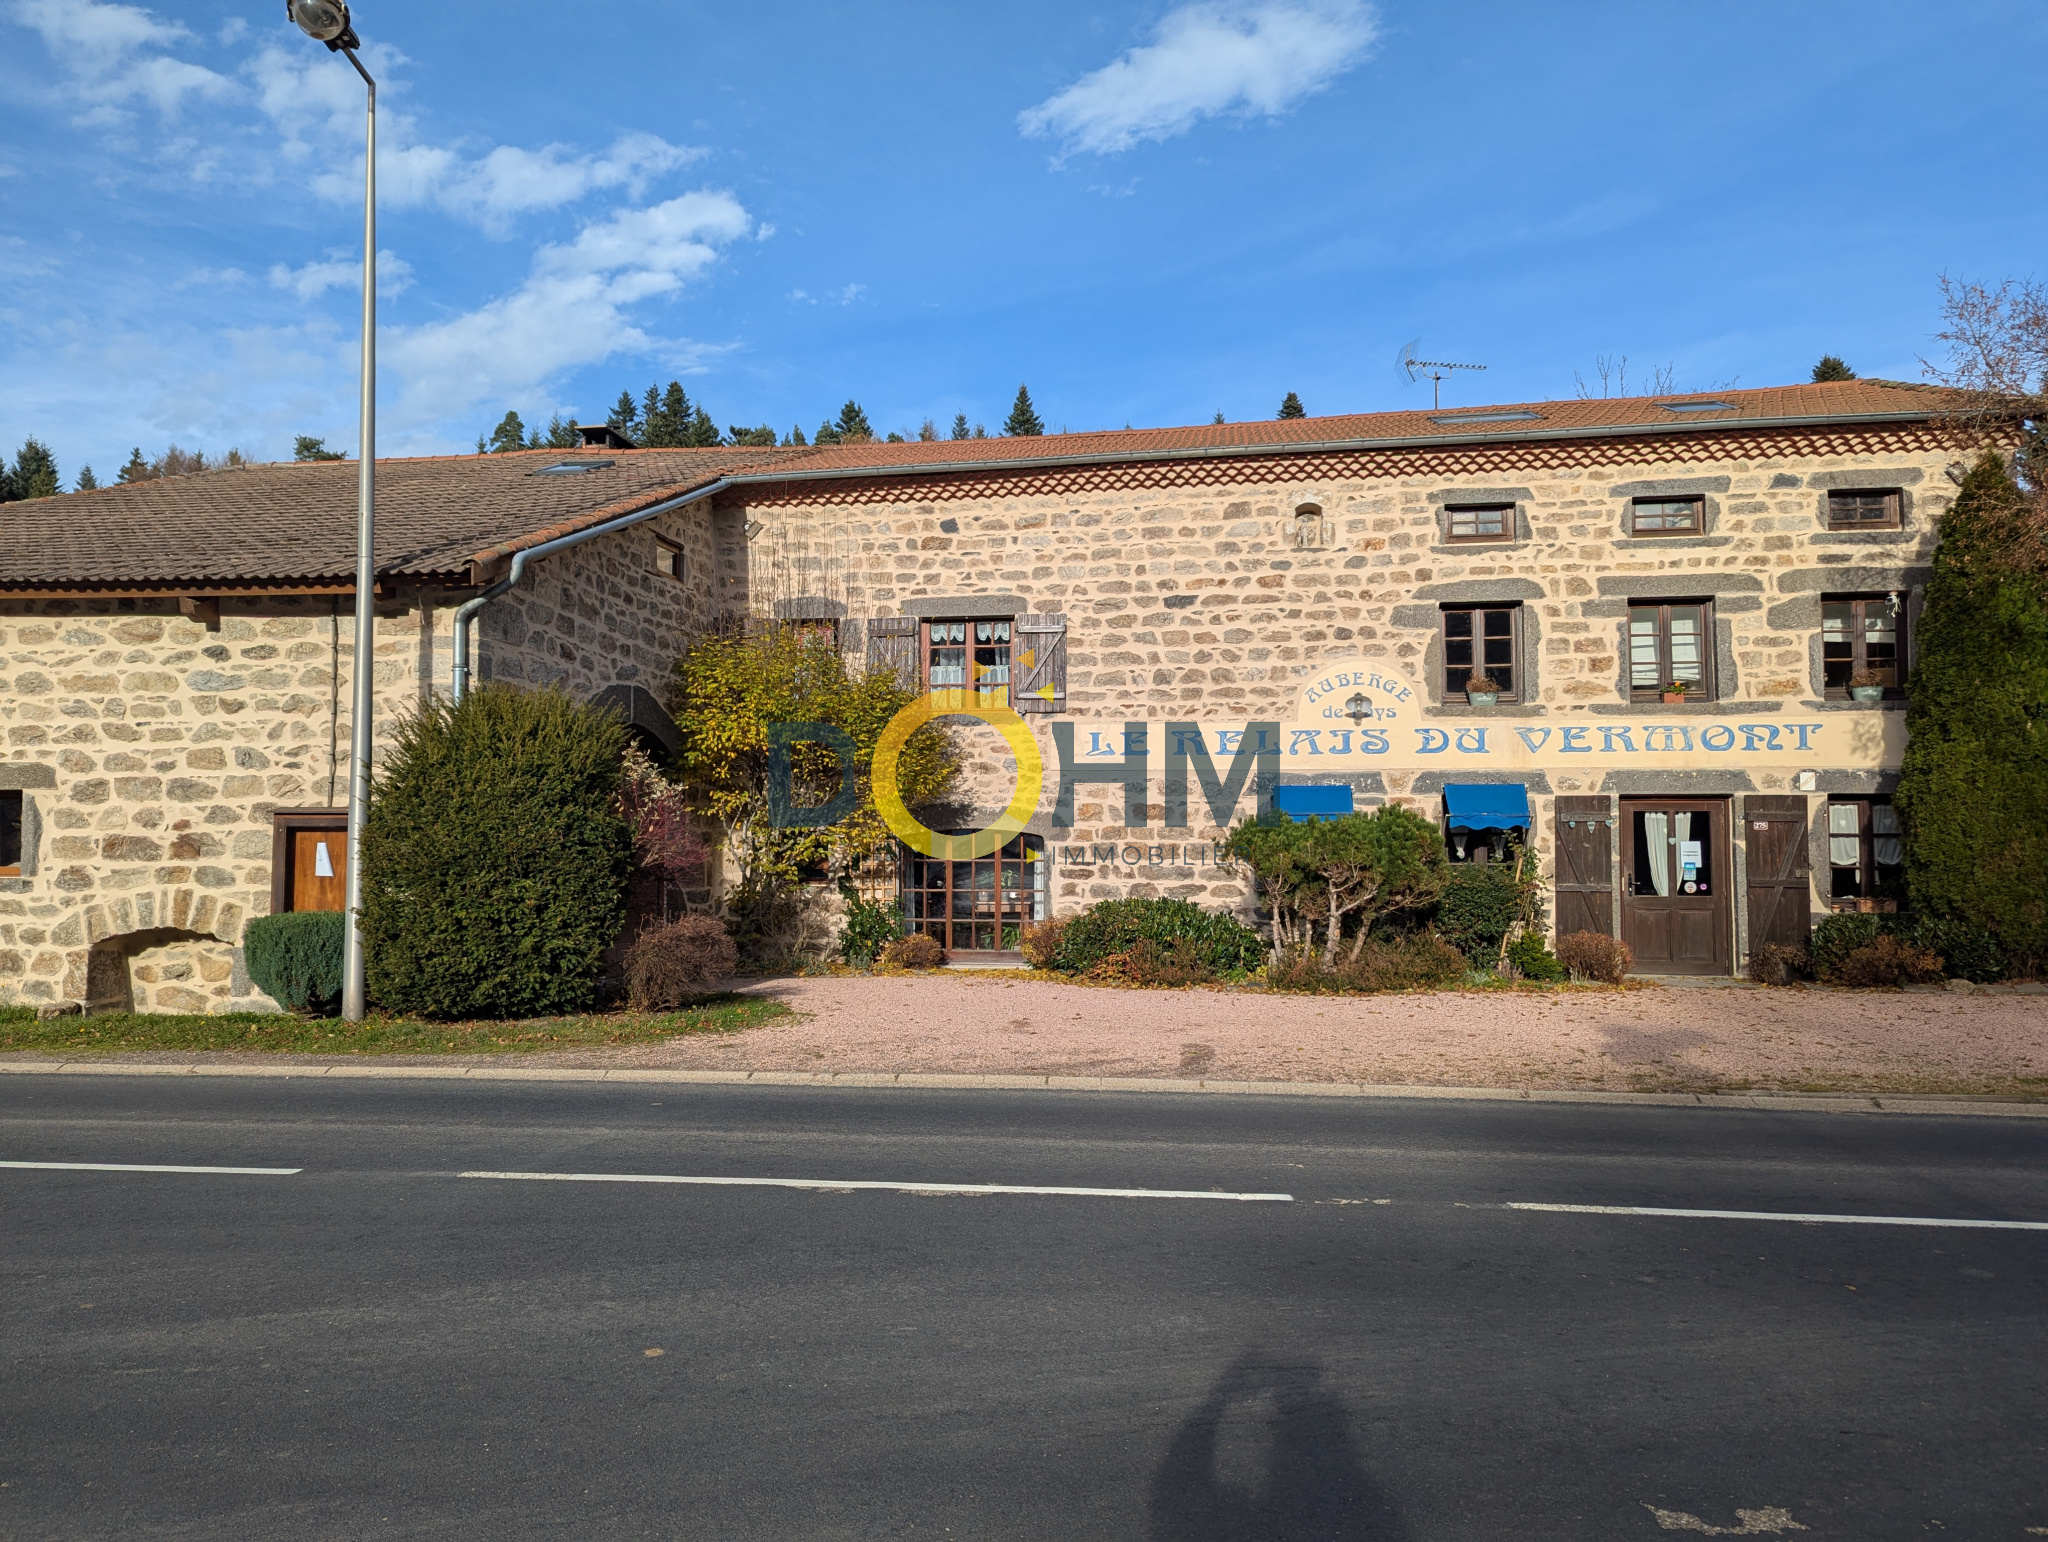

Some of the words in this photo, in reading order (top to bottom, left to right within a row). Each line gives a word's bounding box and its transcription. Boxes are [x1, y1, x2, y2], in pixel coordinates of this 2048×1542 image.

[1304, 671, 1413, 704] AUBERGE
[1322, 705, 1344, 719] de
[1350, 706, 1397, 721] ays
[1085, 731, 1151, 756] LE
[1414, 727, 1491, 754] DU
[1513, 723, 1824, 754] VERMONT
